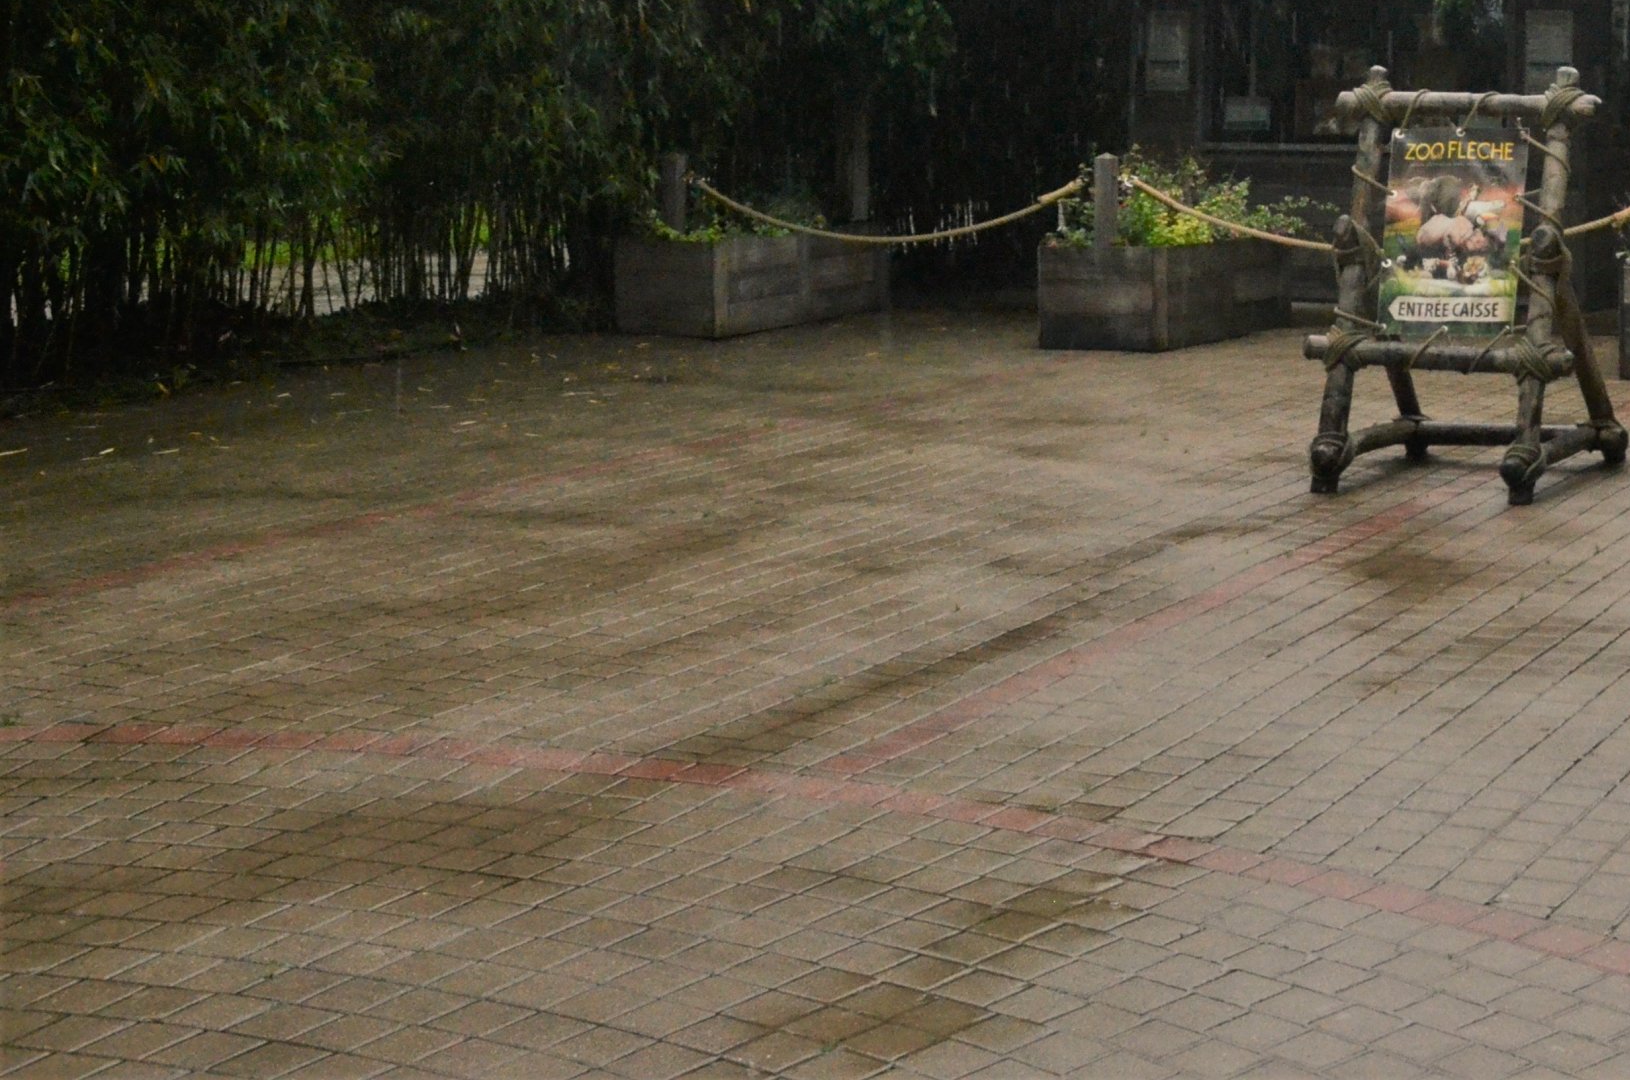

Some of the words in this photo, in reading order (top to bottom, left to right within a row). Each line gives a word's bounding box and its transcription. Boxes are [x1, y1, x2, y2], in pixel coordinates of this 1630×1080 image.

[1404, 142, 1445, 161] ZOO
[1398, 300, 1450, 318] ENTRÉE
[1452, 302, 1499, 318] CAISSE
